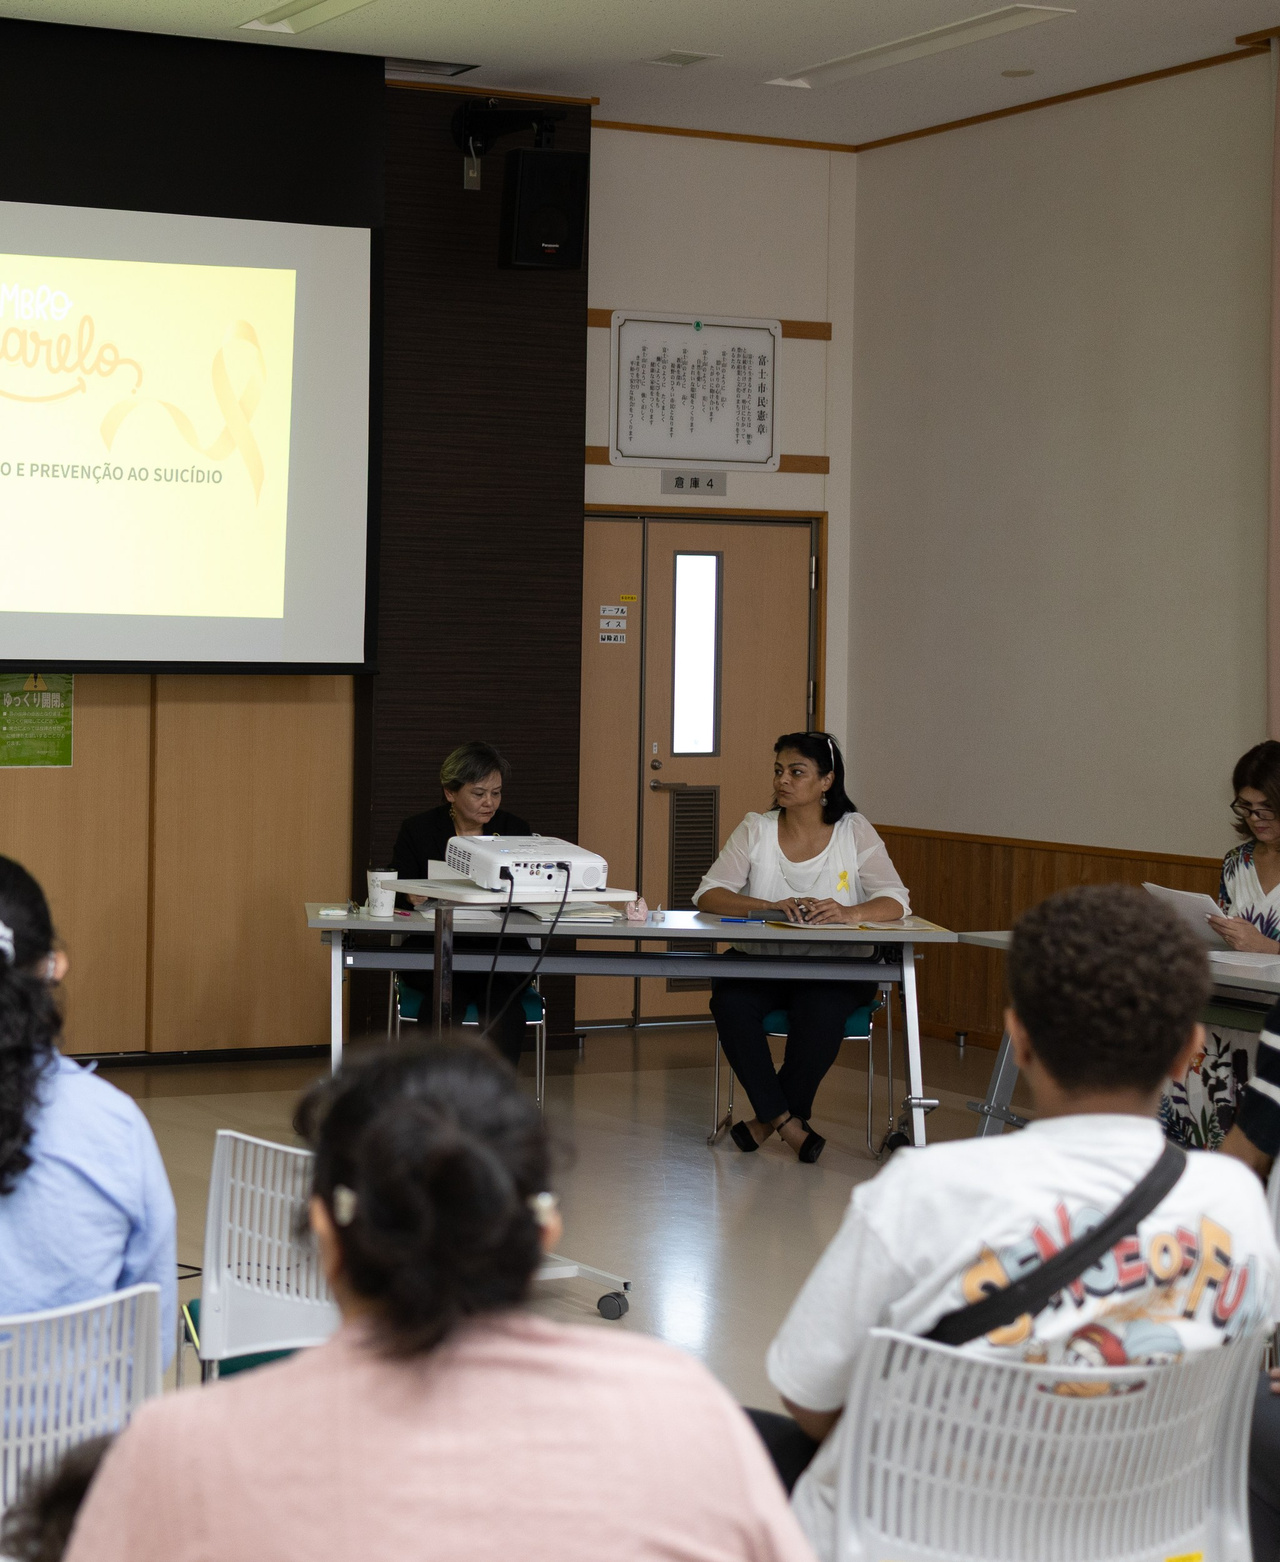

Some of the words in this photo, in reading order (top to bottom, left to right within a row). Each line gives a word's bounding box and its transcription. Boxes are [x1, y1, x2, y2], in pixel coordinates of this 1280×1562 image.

[16, 462, 25, 477] E
[30, 463, 124, 485] PREVENÇÃO
[127, 467, 149, 482] AO
[153, 465, 223, 484] SUICÍDIO
